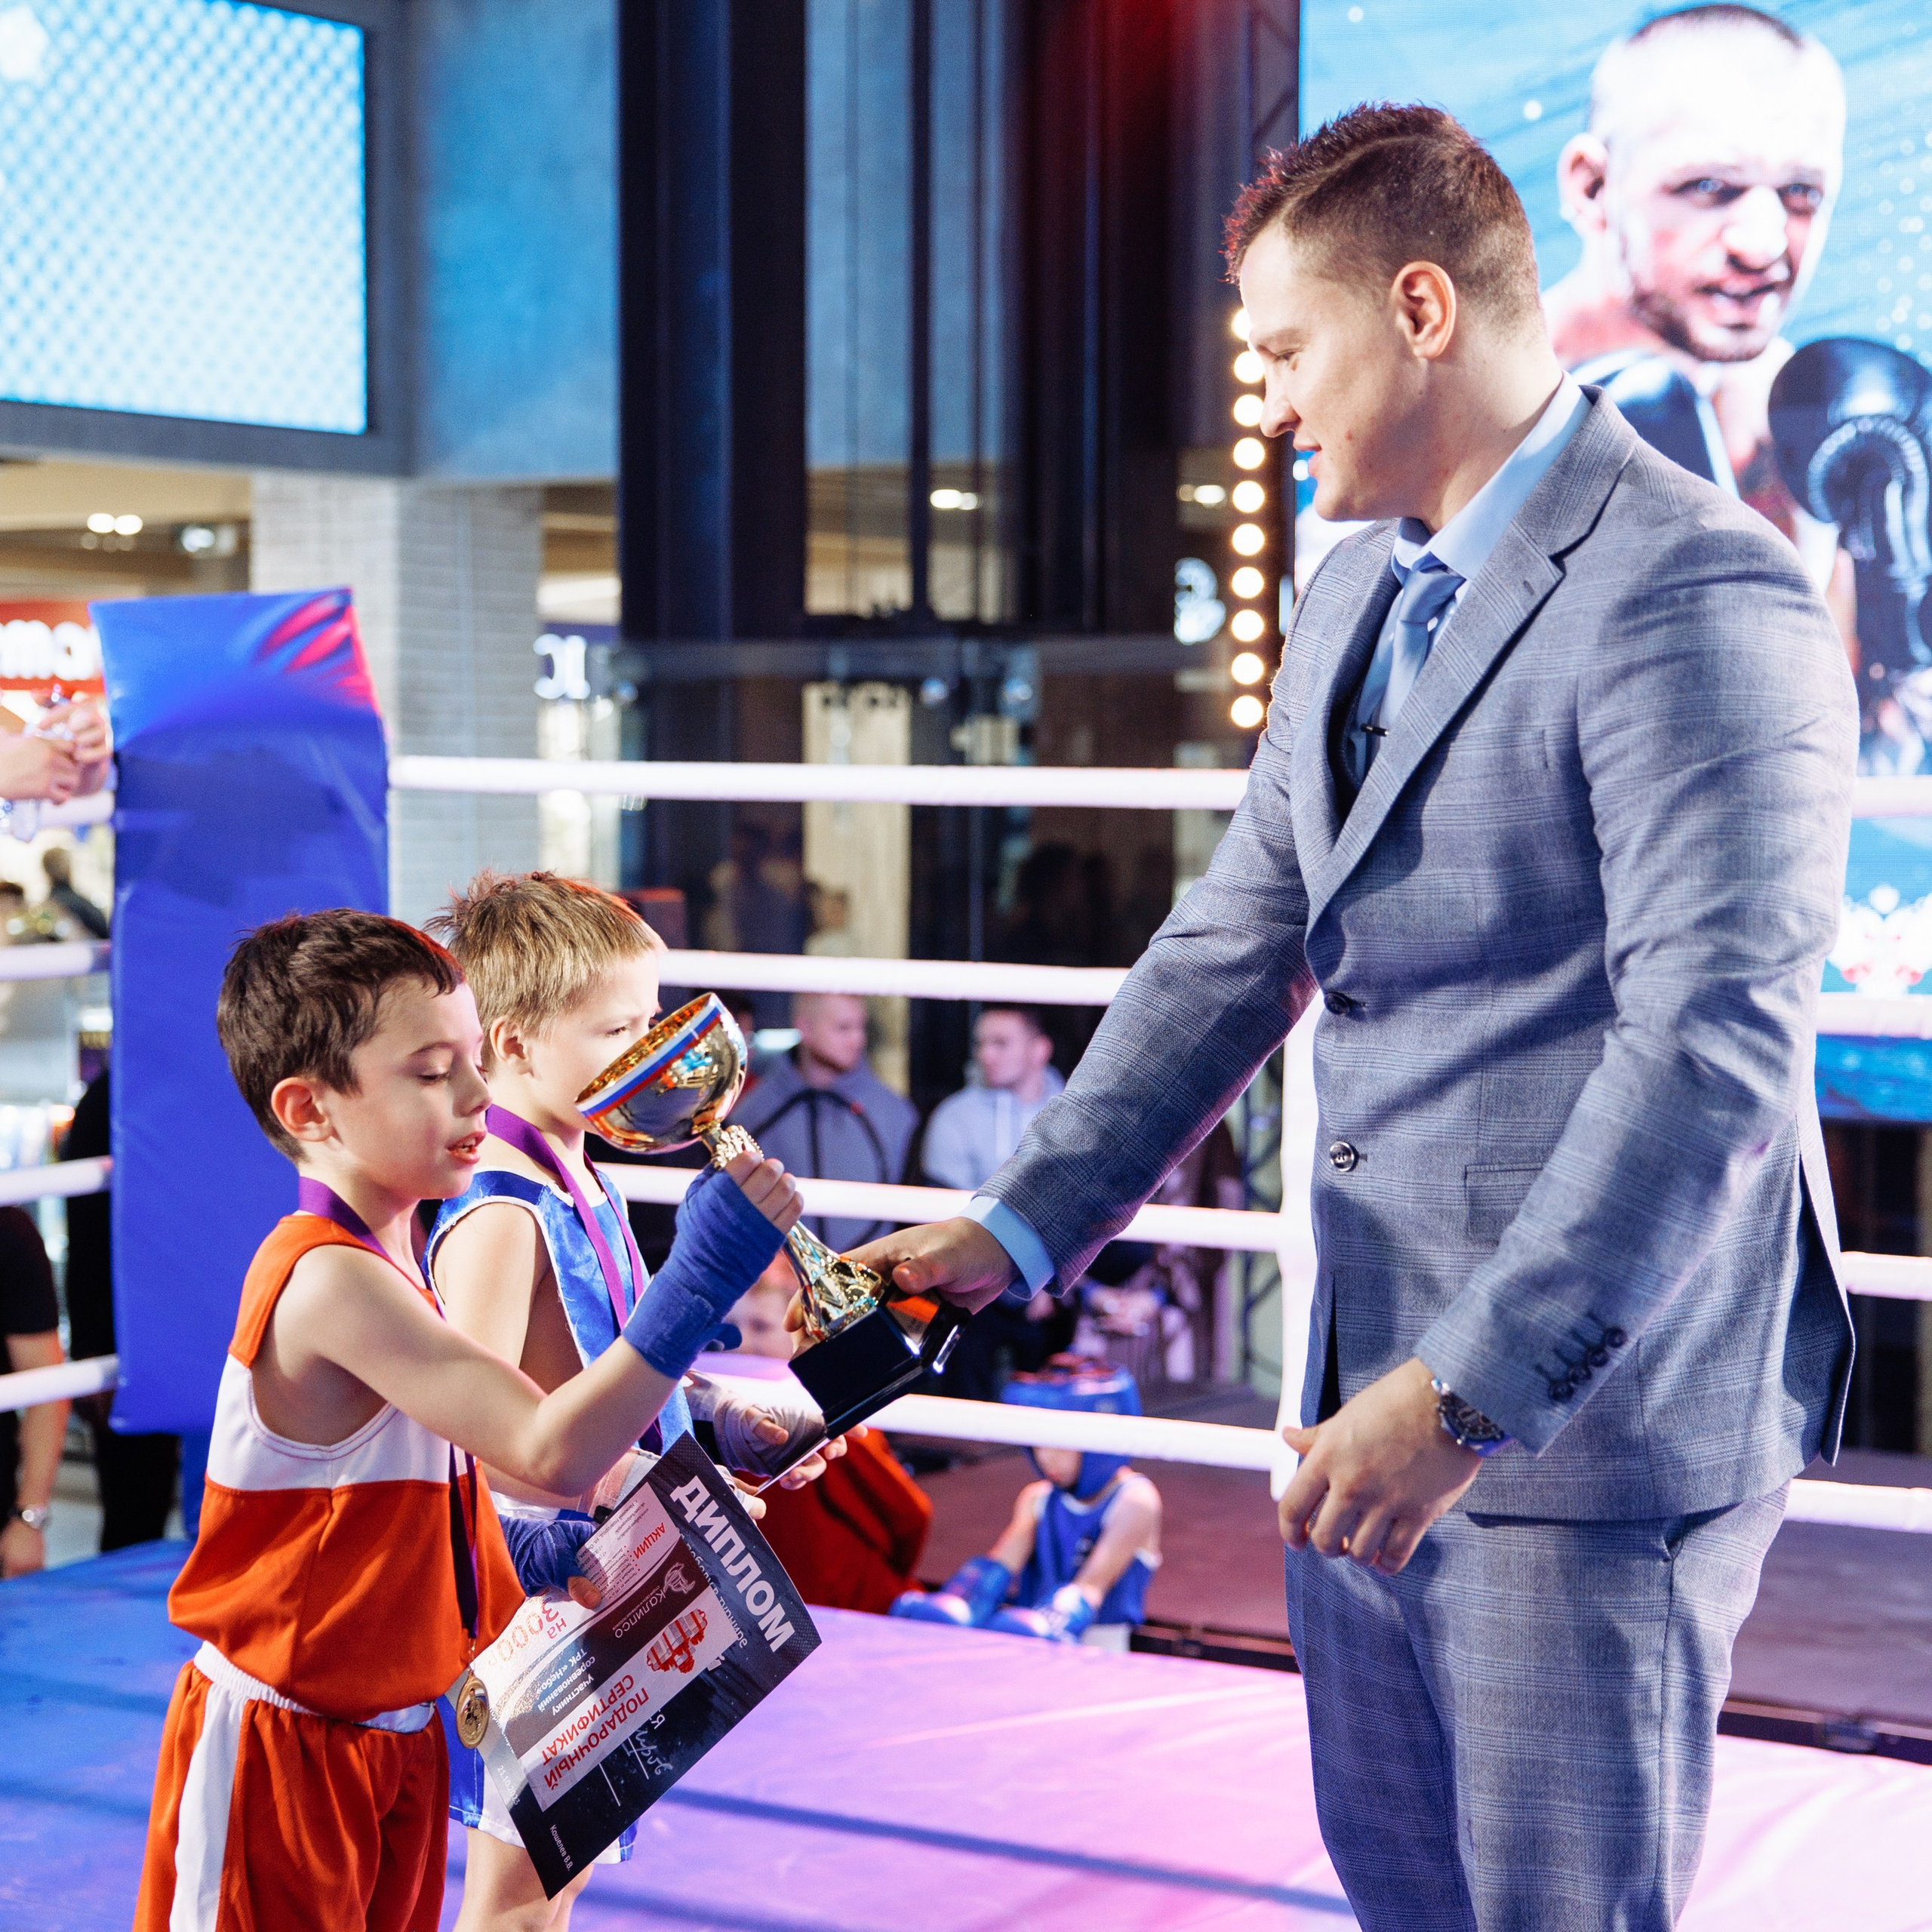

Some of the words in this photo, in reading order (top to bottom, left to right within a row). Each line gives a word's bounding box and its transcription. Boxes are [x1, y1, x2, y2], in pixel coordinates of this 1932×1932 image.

[632, 1521, 665, 1560] АКЦИИ
[667, 1474, 796, 1652] ДИПЛОМ
[546, 1617, 567, 1640] на
[614, 1588, 666, 1638] Калипсо
[568, 1647, 587, 1667] ТРК
[536, 1655, 595, 1712] соревнований
[551, 1672, 595, 1717] участнику
[540, 1674, 635, 1766] СЕРТИФИКАТ
[542, 1687, 649, 1791] ПОДАРОЧНЫЙ
[496, 1764, 521, 1805] 21.10.2023
[549, 1823, 568, 1857] Кошелев
[561, 1854, 575, 1872] В.В.
